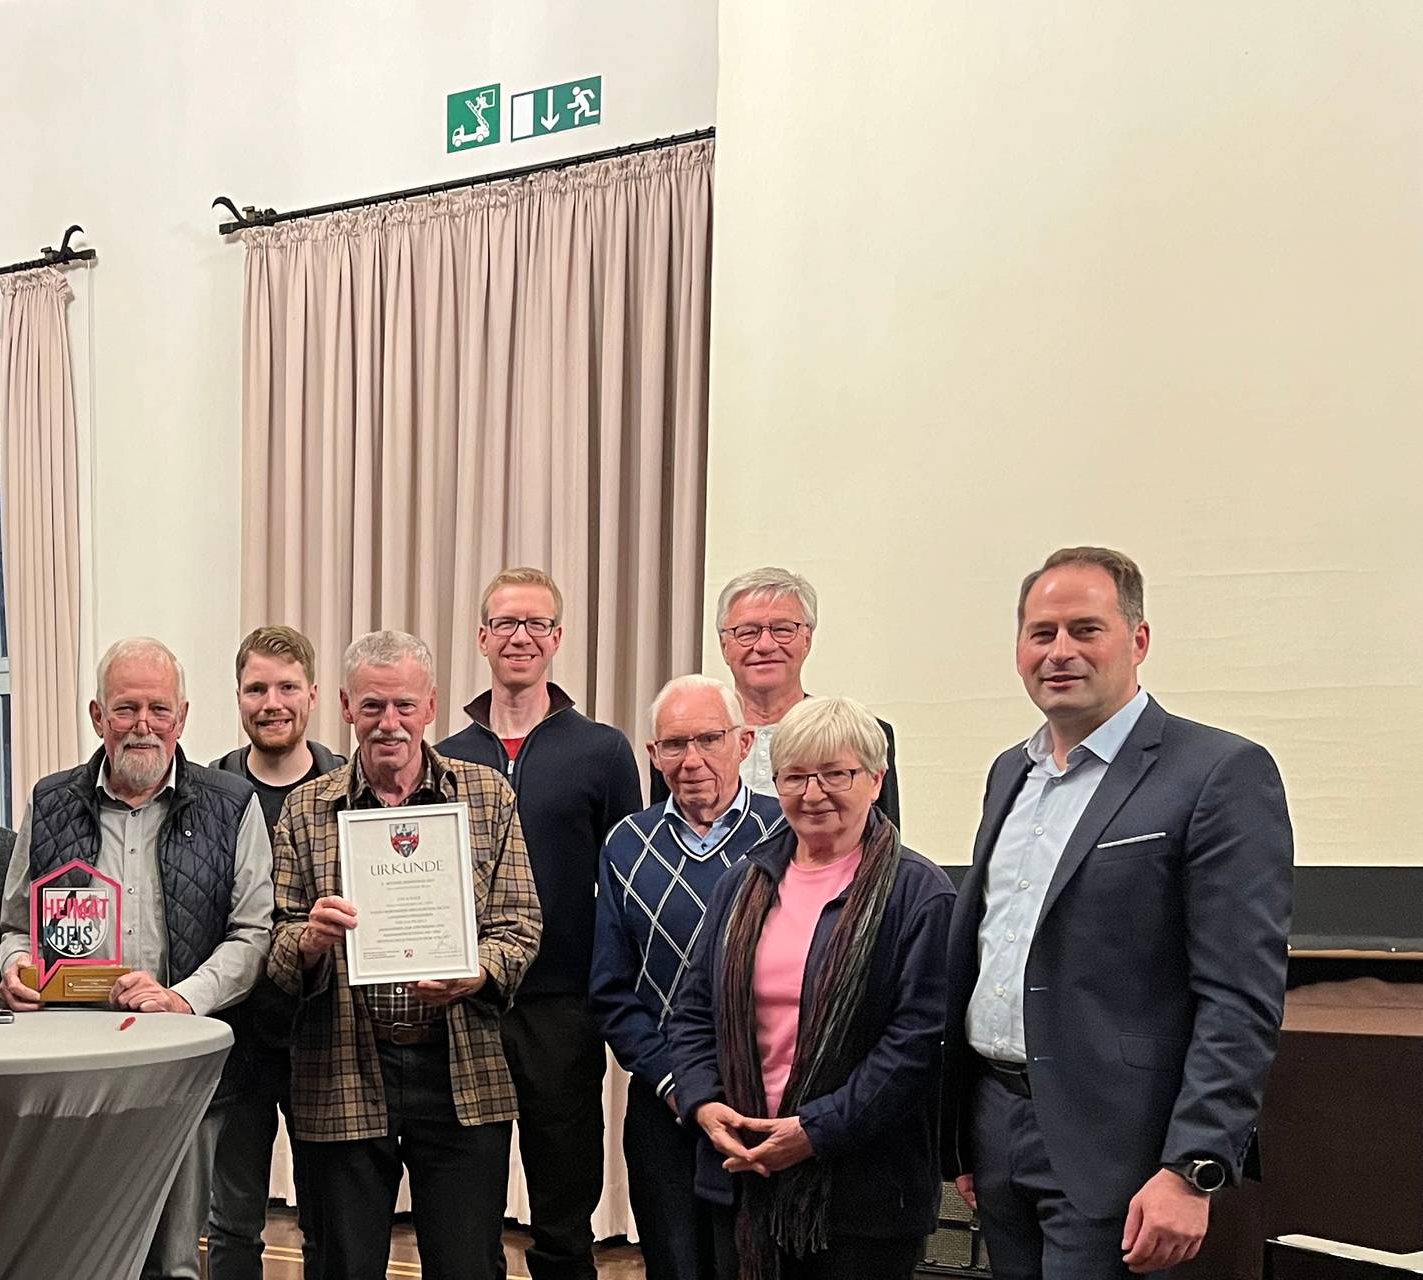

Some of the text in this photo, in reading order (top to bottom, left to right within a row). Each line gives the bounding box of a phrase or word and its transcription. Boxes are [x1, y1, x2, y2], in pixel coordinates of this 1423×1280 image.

[370, 860, 444, 876] URKUNDE
[44, 897, 109, 919] HEIMAT
[43, 925, 92, 946] PREIS
